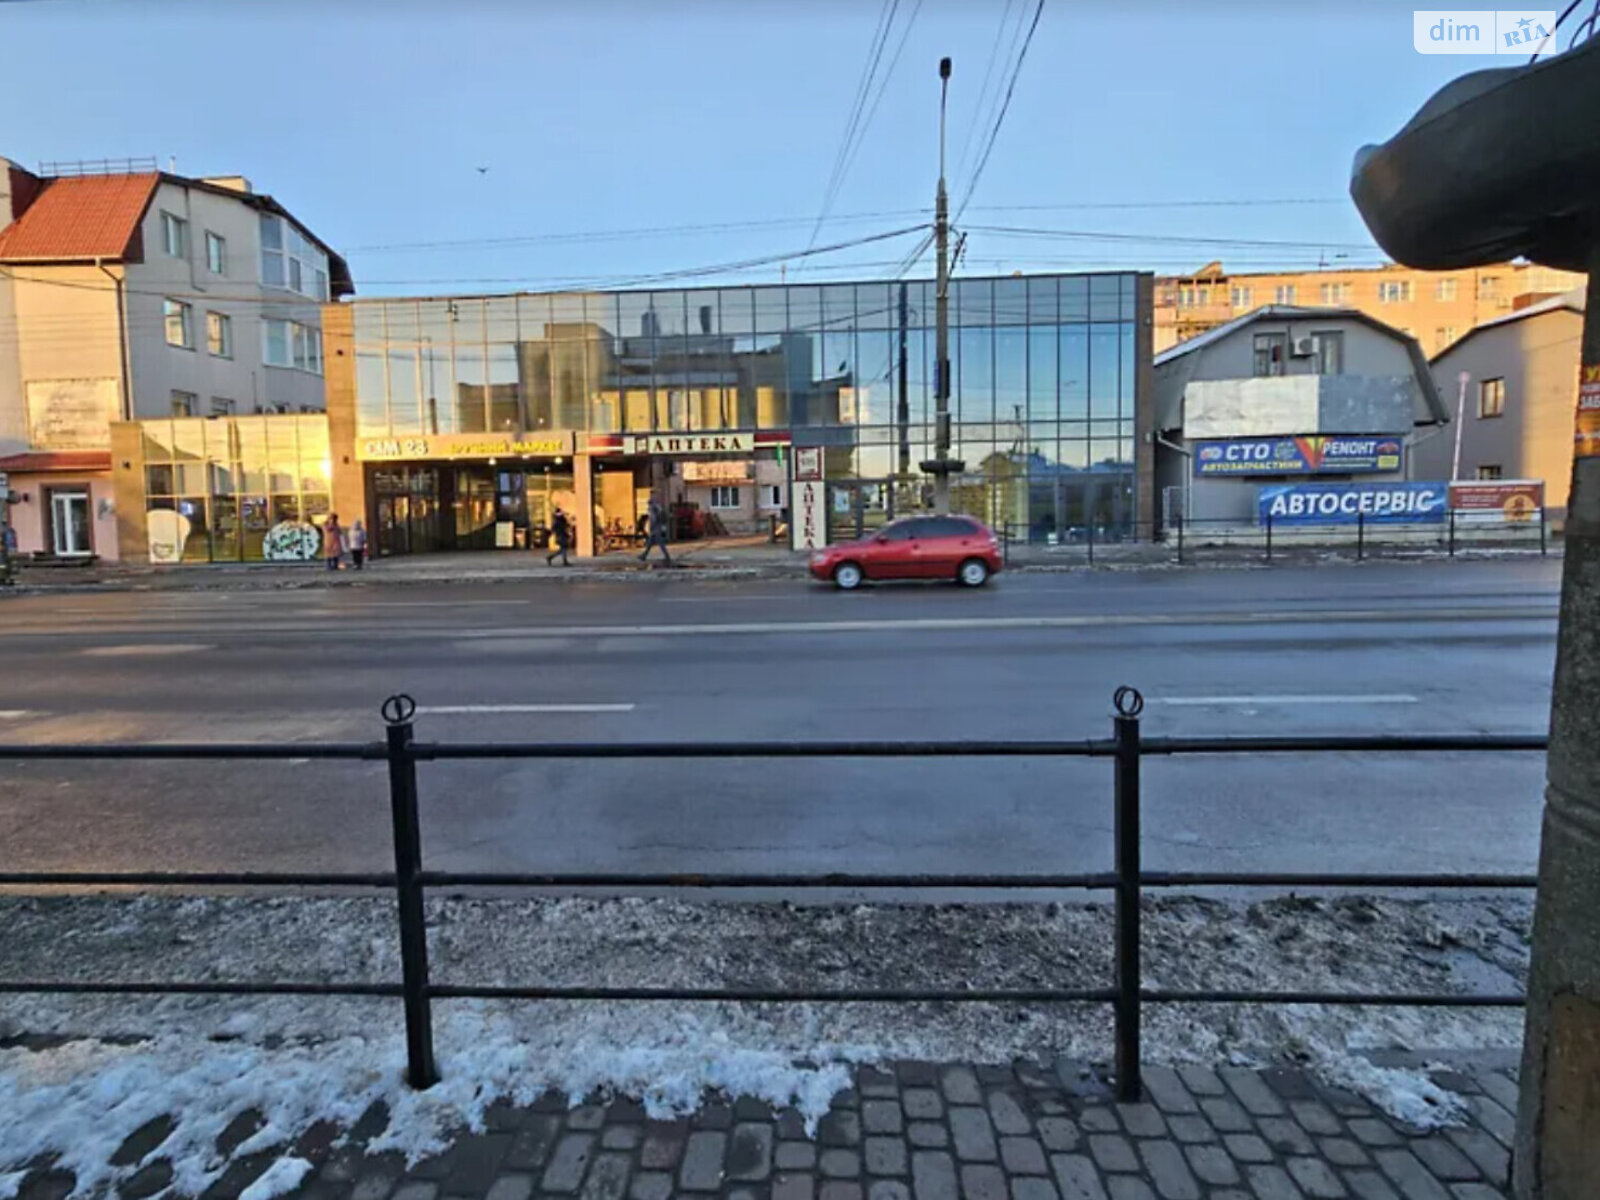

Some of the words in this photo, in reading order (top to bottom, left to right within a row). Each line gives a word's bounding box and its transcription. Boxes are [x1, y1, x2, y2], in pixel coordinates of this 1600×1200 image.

[653, 436, 742, 451] АПТЕКА
[1226, 443, 1270, 461] СТО
[1322, 441, 1377, 455] РЕМОНТ
[1269, 490, 1434, 516] АВТОСЕРВІС
[803, 482, 815, 549] АПТЕКА
